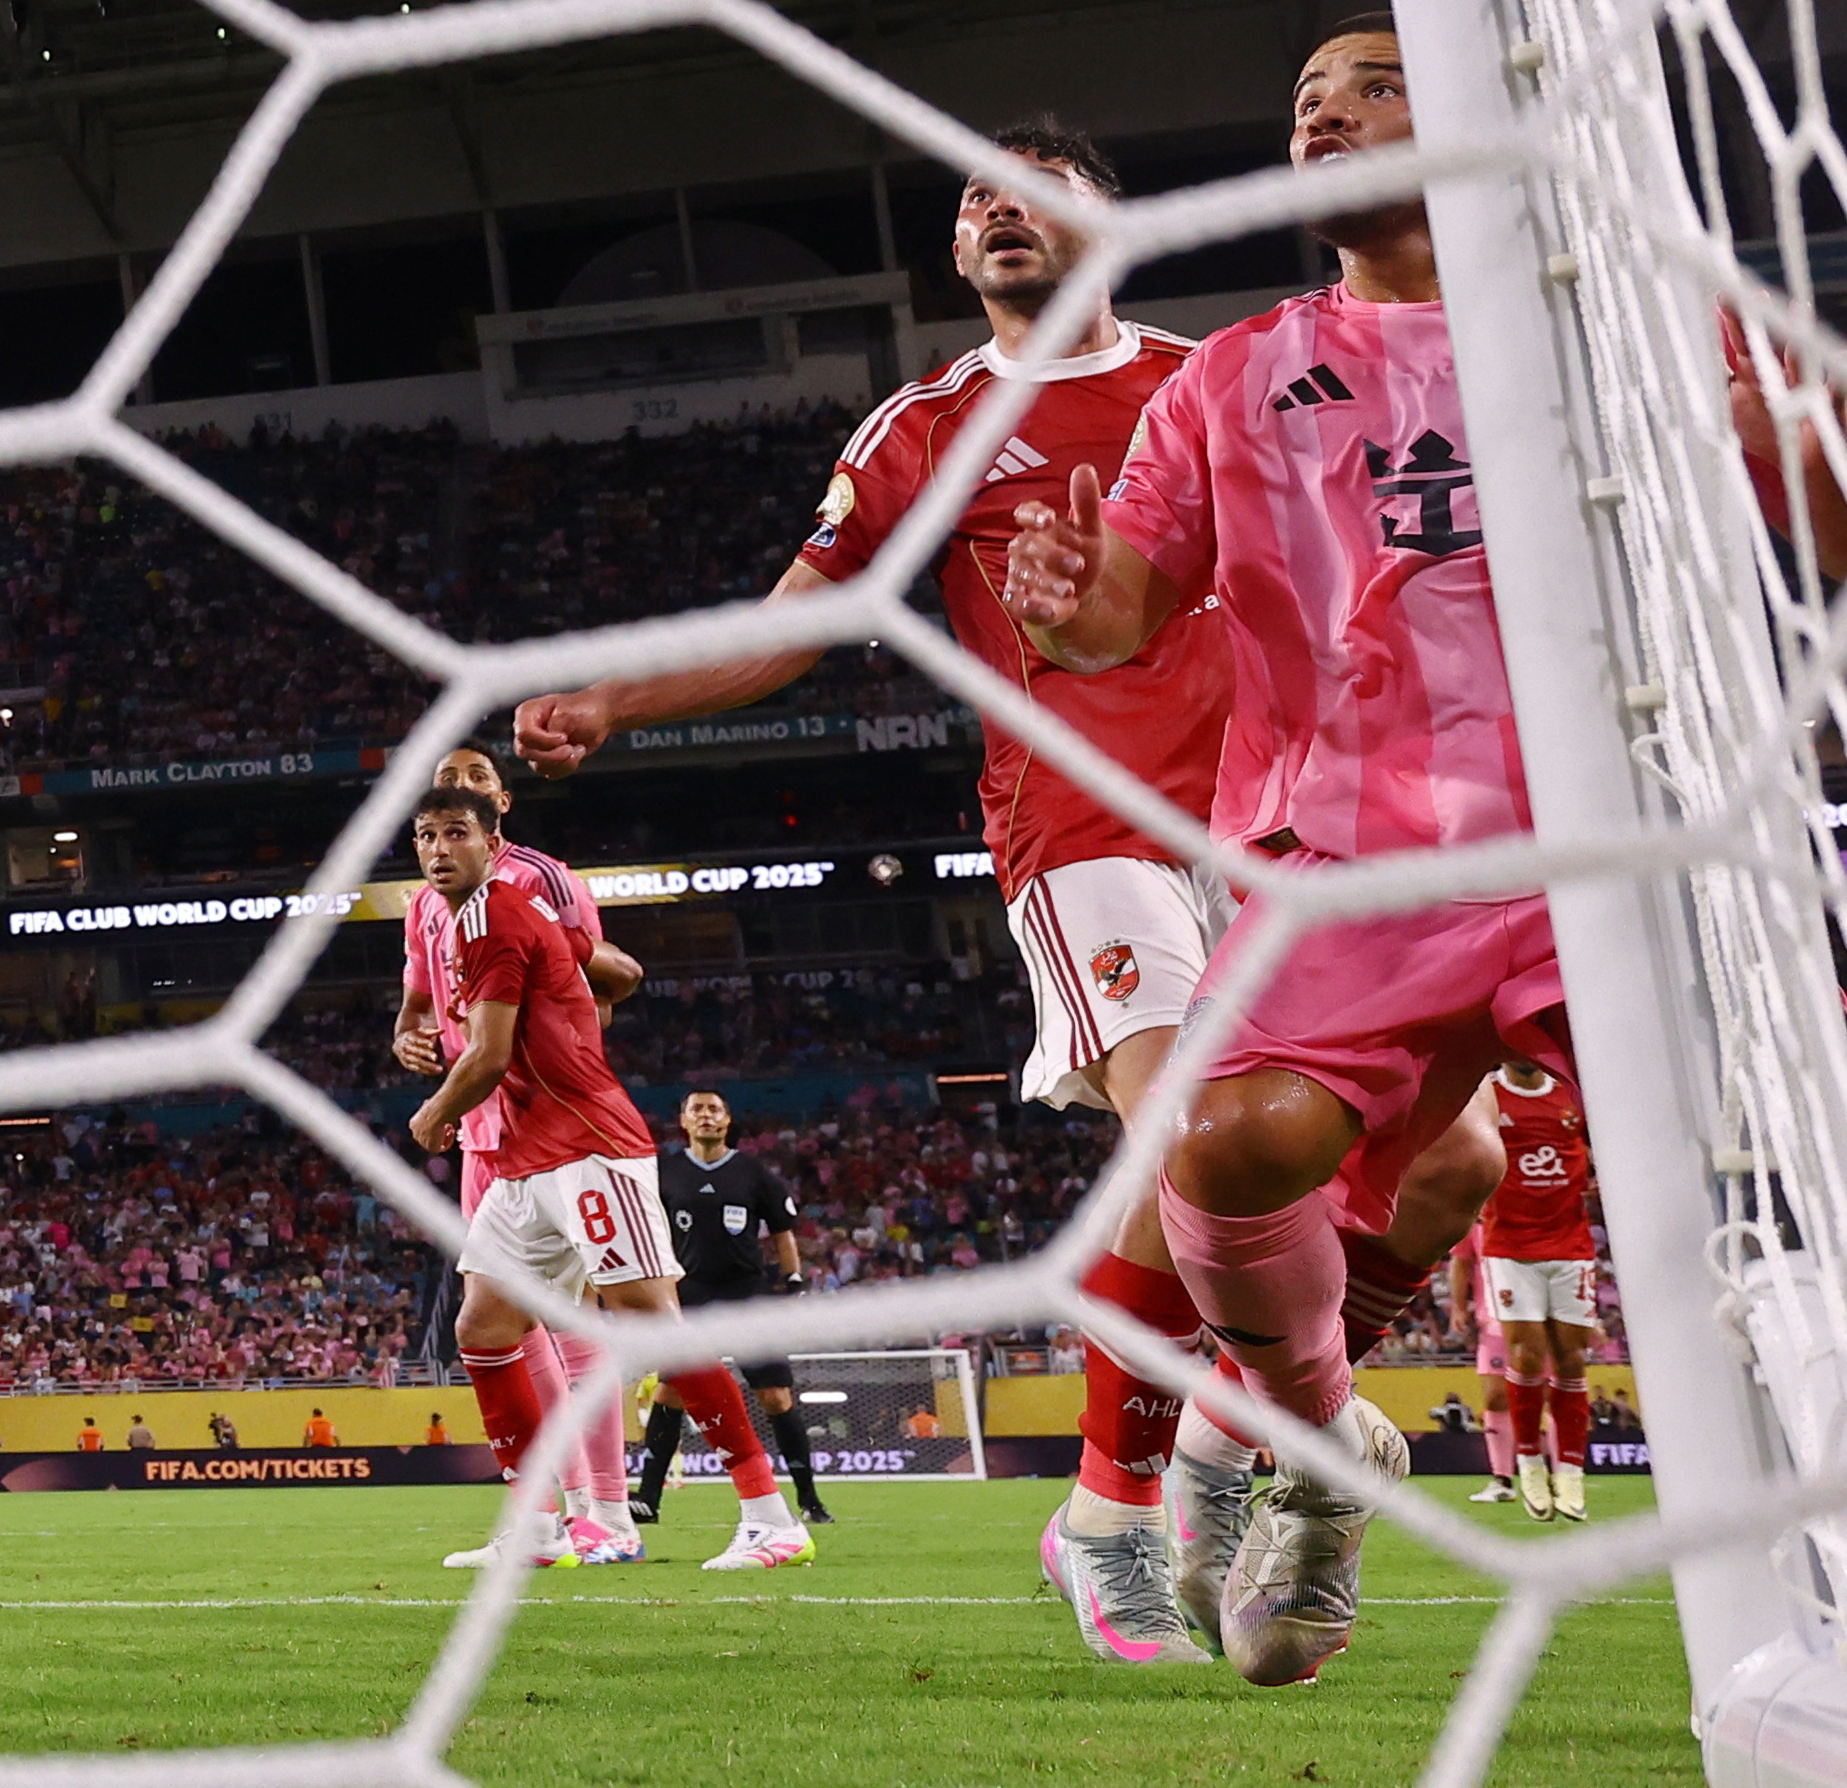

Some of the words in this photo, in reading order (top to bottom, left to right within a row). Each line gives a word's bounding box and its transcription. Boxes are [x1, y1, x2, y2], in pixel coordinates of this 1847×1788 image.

[630, 728, 683, 750] DAN
[690, 720, 790, 745] MARINO
[798, 716, 826, 737] 13
[855, 713, 950, 753] NRN
[90, 768, 160, 788] MARK
[166, 759, 272, 782] CLAYTON
[280, 753, 314, 775] 83
[934, 851, 996, 879] FIFA
[587, 868, 690, 899] WORLD
[691, 866, 749, 894] CUP
[8, 910, 64, 935] FIFA
[65, 907, 131, 932] CLUB
[133, 900, 227, 928] WORLD
[229, 896, 283, 921] CUP
[577, 1189, 617, 1245] 8
[145, 1457, 372, 1481] FIFA.COM/TICKETS
